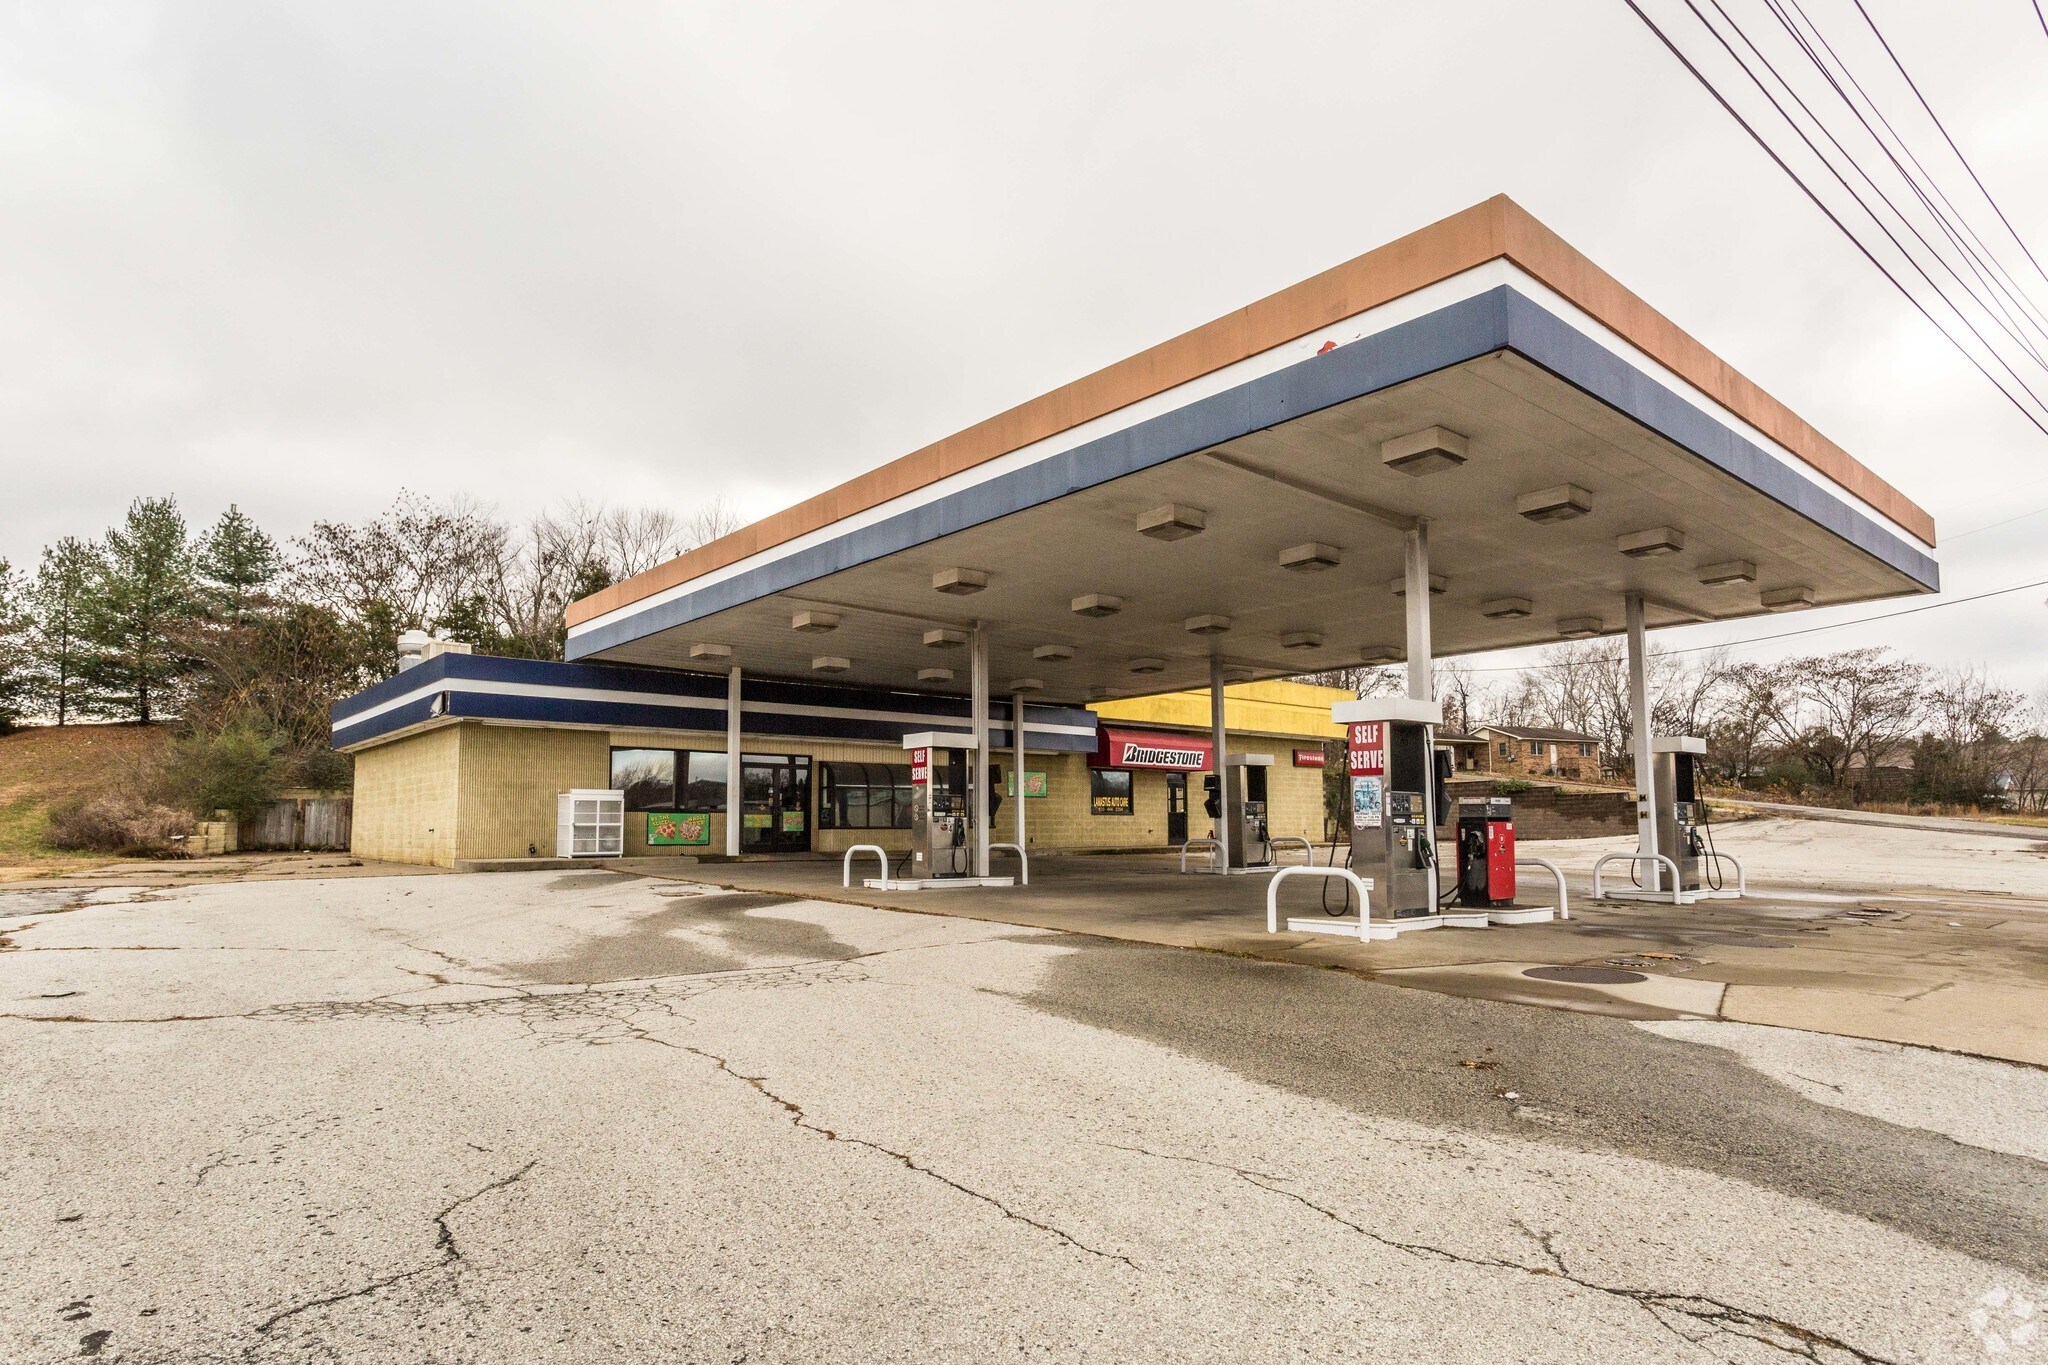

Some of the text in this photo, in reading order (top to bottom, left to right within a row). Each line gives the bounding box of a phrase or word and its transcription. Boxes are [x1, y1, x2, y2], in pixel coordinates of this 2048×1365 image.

[1354, 724, 1378, 744] SELF
[914, 749, 925, 764] SELF
[1123, 744, 1203, 767] BRIDGESTONE
[1350, 749, 1384, 770] SERVE
[912, 767, 928, 781] SERVE
[1120, 797, 1129, 807] CARE
